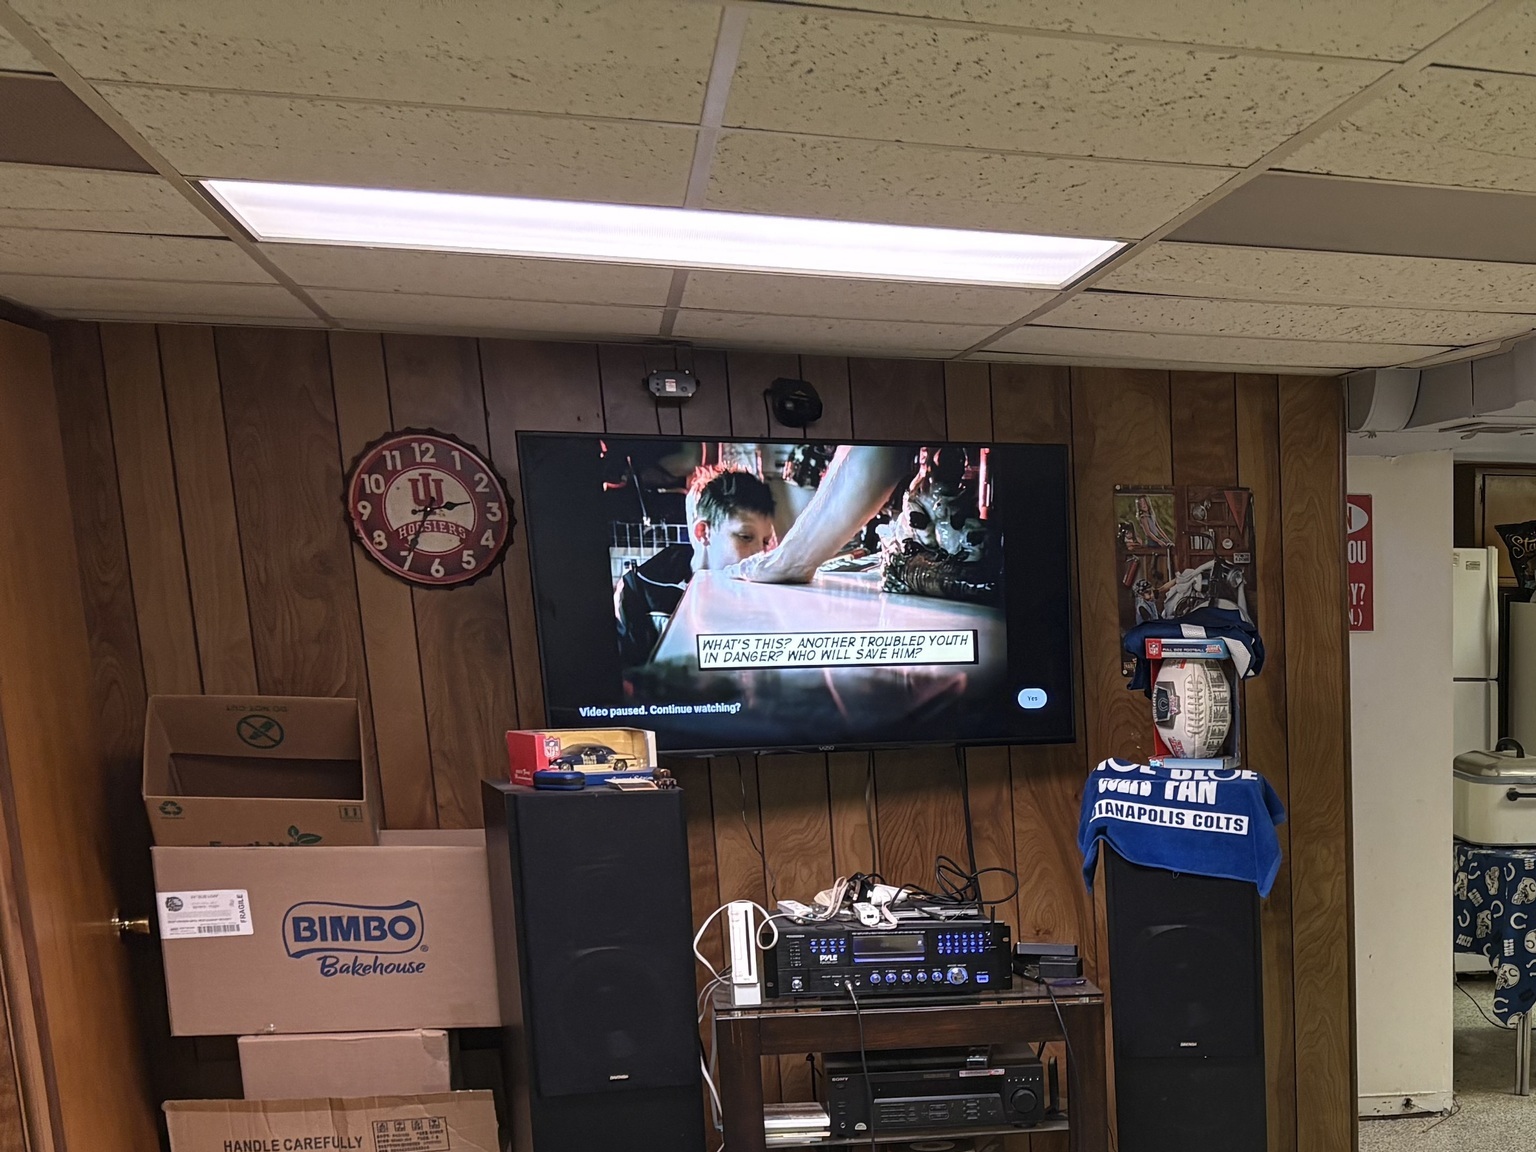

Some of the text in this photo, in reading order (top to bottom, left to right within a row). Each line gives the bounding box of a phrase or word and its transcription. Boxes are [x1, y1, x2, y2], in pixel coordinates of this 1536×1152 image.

[383, 451, 402, 470] 11
[411, 443, 436, 463] 12
[451, 451, 462, 470] 1
[361, 474, 385, 494] 10
[474, 473, 489, 492] 2
[357, 501, 371, 520] 9
[486, 502, 502, 522] 3
[373, 530, 388, 550] 8
[480, 529, 495, 549] 4
[400, 551, 414, 571] 7
[461, 550, 476, 570] 5
[1347, 540, 1367, 563] OU
[430, 558, 445, 578] 6
[702, 634, 969, 651] WHAT'S THIS? ANOTHER TROUBLED YOUTH
[704, 647, 923, 663] IN DANGER? WHO WILL SAVE HIM?
[578, 702, 742, 719] Video paused. Continue watching?
[1193, 814, 1245, 833] COLTS
[236, 894, 247, 923] FRAGILE
[292, 915, 416, 942] BIMBO
[316, 955, 426, 977] Bakehouse
[223, 1139, 280, 1152] HANDLE
[284, 1135, 363, 1151] CAREFULLY
